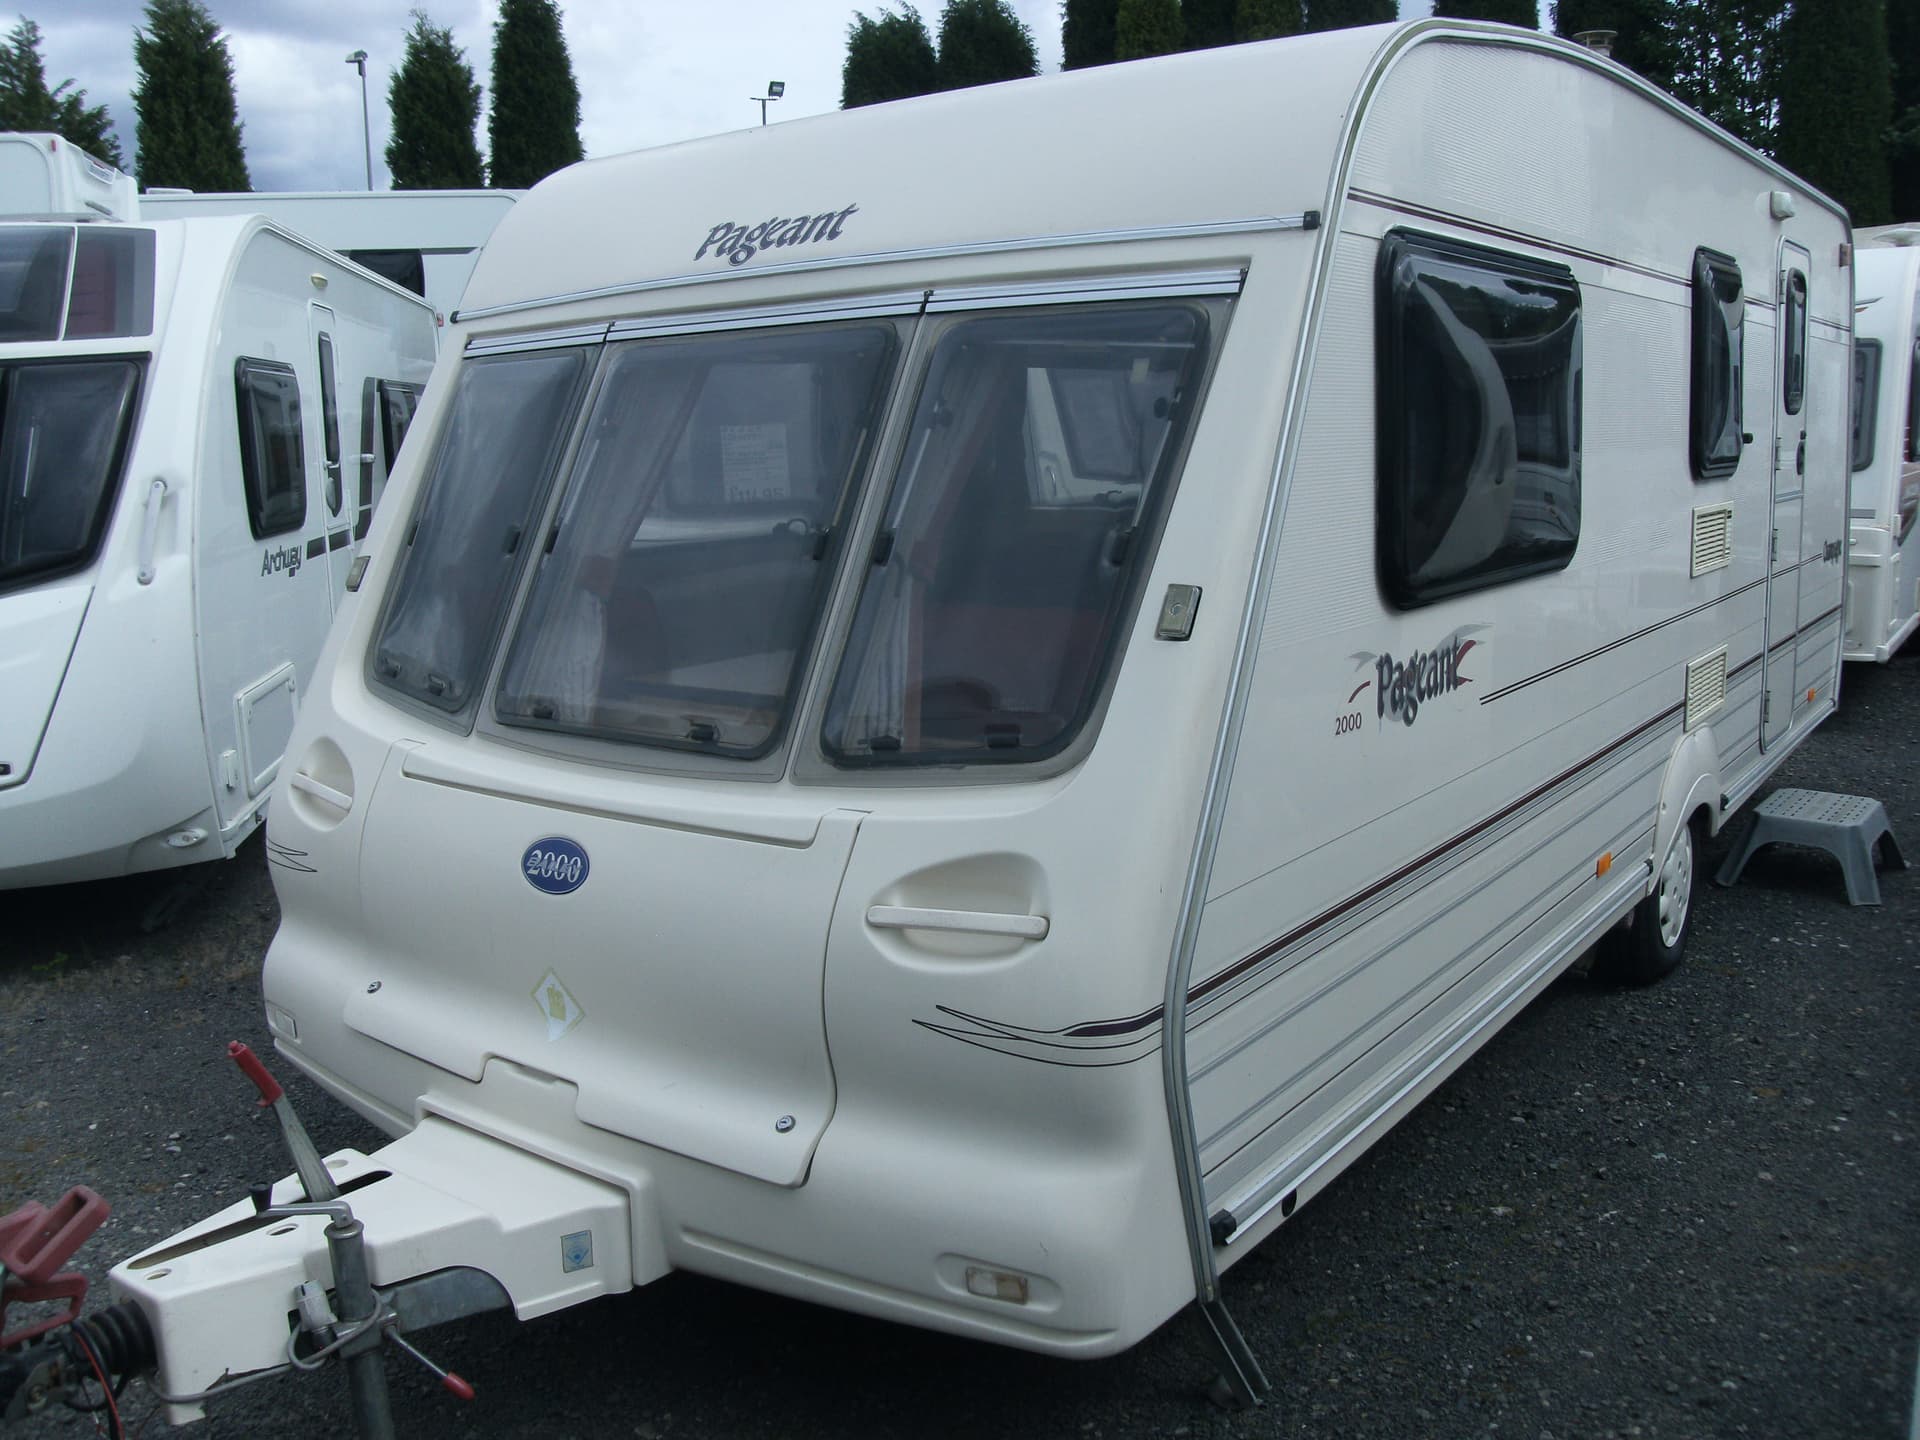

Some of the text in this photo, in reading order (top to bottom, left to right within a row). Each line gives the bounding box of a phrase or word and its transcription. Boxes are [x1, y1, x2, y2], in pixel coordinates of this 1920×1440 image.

[693, 203, 860, 266] Pageant
[261, 545, 303, 577] Archway
[1375, 635, 1461, 728] Pageant
[1335, 712, 1363, 736] 2000
[527, 849, 582, 883] 2000
